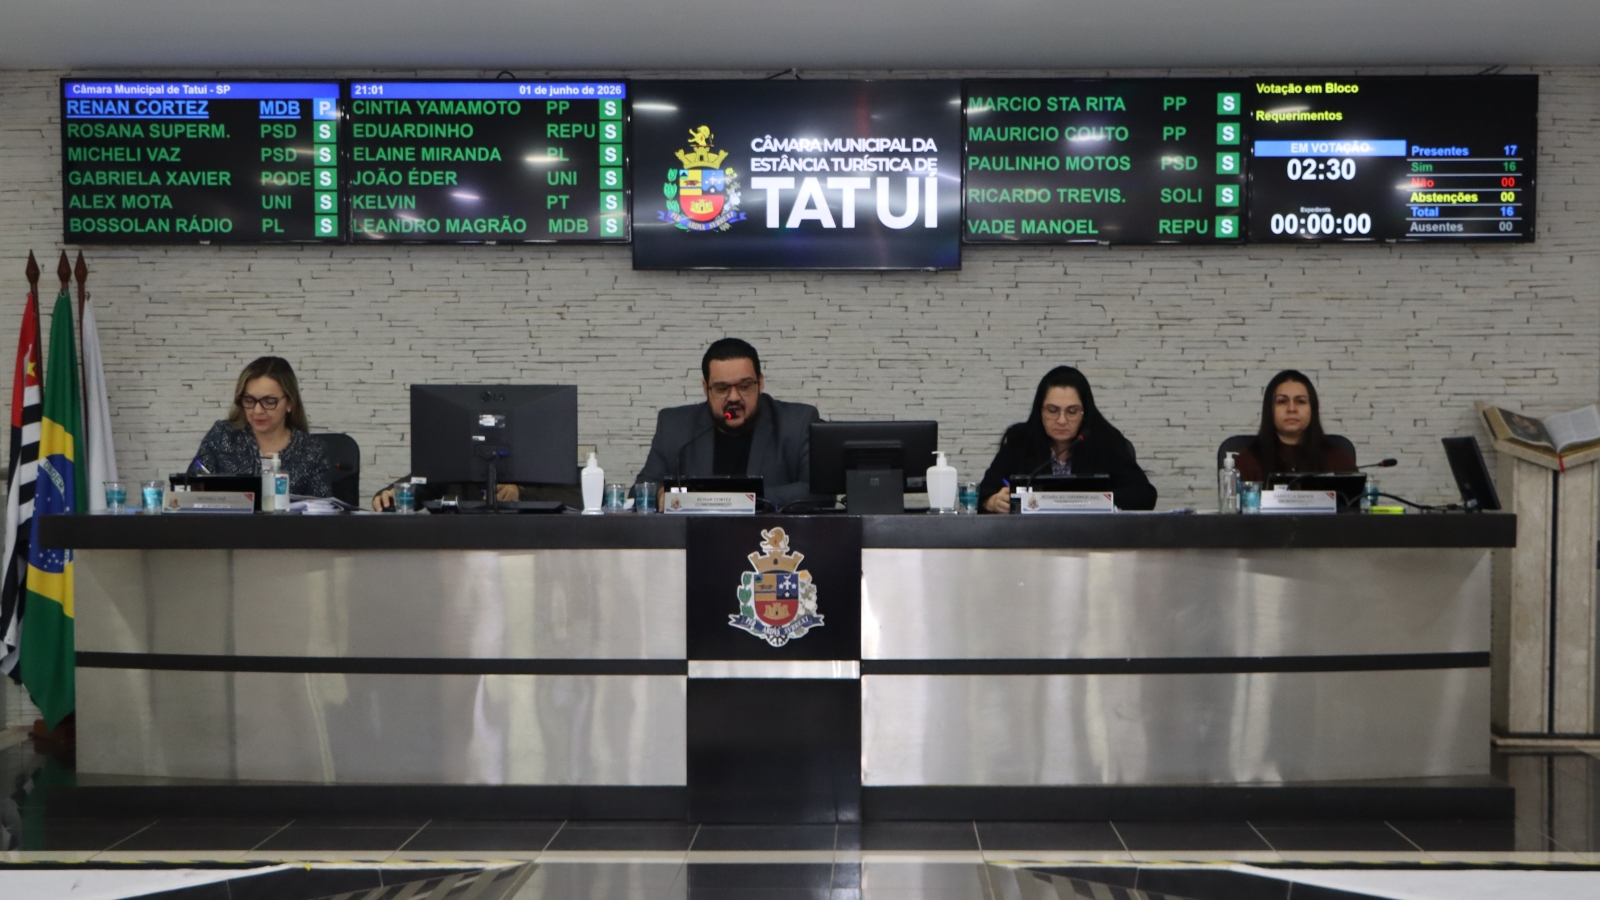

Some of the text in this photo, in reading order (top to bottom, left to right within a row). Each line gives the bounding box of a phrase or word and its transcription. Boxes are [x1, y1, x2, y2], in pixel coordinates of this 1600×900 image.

[73, 84, 112, 94] Câmara
[115, 84, 164, 96] Municipal
[167, 85, 179, 94] de
[216, 86, 230, 94] SP
[355, 86, 384, 94] 21:01
[520, 86, 621, 96] 01 de junho de 2026
[1256, 84, 1302, 95] Votação
[1325, 84, 1358, 93] Bloco
[67, 100, 208, 114] RENAN CORTEZ
[260, 102, 300, 114] MDB
[320, 102, 330, 114] P
[353, 100, 521, 115] CINTIA YAMAMOTO
[547, 101, 569, 114] PP
[605, 102, 616, 116] S
[969, 97, 1126, 112] MARCIO STA RITA
[1164, 98, 1187, 111] PP
[1223, 97, 1234, 110] S
[1256, 111, 1342, 122] Requerimentos
[68, 124, 230, 138] ROSANA SUPERM.
[261, 124, 296, 138] PSD
[320, 125, 330, 138] S
[353, 124, 473, 138] EDUARDINHO
[547, 124, 595, 138] REPU
[605, 125, 616, 139] S
[969, 127, 1129, 141] MAURICIO COUTO
[1163, 127, 1186, 140] PP
[1223, 127, 1234, 140] S
[751, 135, 937, 152] CÂMARA MUNICIPAL DA
[1291, 142, 1369, 155] EM VOTAÇÃO
[68, 148, 180, 161] MICHELI VAZ
[261, 148, 297, 162] PSD
[320, 148, 331, 162] S
[354, 148, 501, 161] ELAINE MIRANDA
[605, 148, 616, 162] S
[1412, 146, 1469, 156] Presentes
[1504, 146, 1517, 155] 17
[751, 154, 937, 172] ESTÂNCIA TURÍSTICA DE
[969, 157, 1130, 170] PAULINHO MOTOS
[1161, 157, 1197, 170] PSD
[1222, 156, 1233, 170] S
[1287, 159, 1356, 180] 02:30
[1412, 162, 1432, 172] Sim
[1504, 162, 1516, 171] 16
[69, 172, 231, 185] GABRIELA XAVIER
[261, 172, 311, 185] PODE
[320, 172, 331, 185] S
[353, 168, 457, 185] JOÃO ÉDER
[548, 172, 577, 185] UNI
[605, 172, 616, 185] S
[1411, 178, 1434, 187] Não
[1501, 178, 1515, 187] 00
[69, 195, 172, 208] ALEX MOTA
[751, 172, 937, 229] TATUÍ
[968, 189, 1125, 203] RICARDO TREVIS.
[1160, 189, 1202, 203] SOLI
[1222, 189, 1233, 202] S
[1410, 192, 1478, 204] Abstenções
[1501, 193, 1514, 202] 00
[262, 196, 291, 209] UNI
[321, 196, 332, 209] S
[353, 196, 416, 209] KELVIN
[547, 196, 569, 209] PT
[606, 196, 617, 209] S
[1411, 207, 1439, 217] Total
[1501, 207, 1514, 216] 16
[70, 215, 232, 232] BOSSOLAN RÁDIO
[262, 219, 284, 232] PL
[321, 220, 332, 233] S
[353, 216, 526, 233] LEANDRO MAGRÃO
[549, 220, 588, 232] MDB
[606, 220, 617, 233] S
[968, 220, 1098, 234] VADE MANOEL
[1159, 220, 1208, 234] REPU
[1221, 220, 1232, 234] S
[1271, 214, 1370, 234] 00:00:00
[1410, 222, 1463, 232] Ausentes
[1499, 222, 1512, 231] 00
[43, 461, 64, 490] ORDEM
